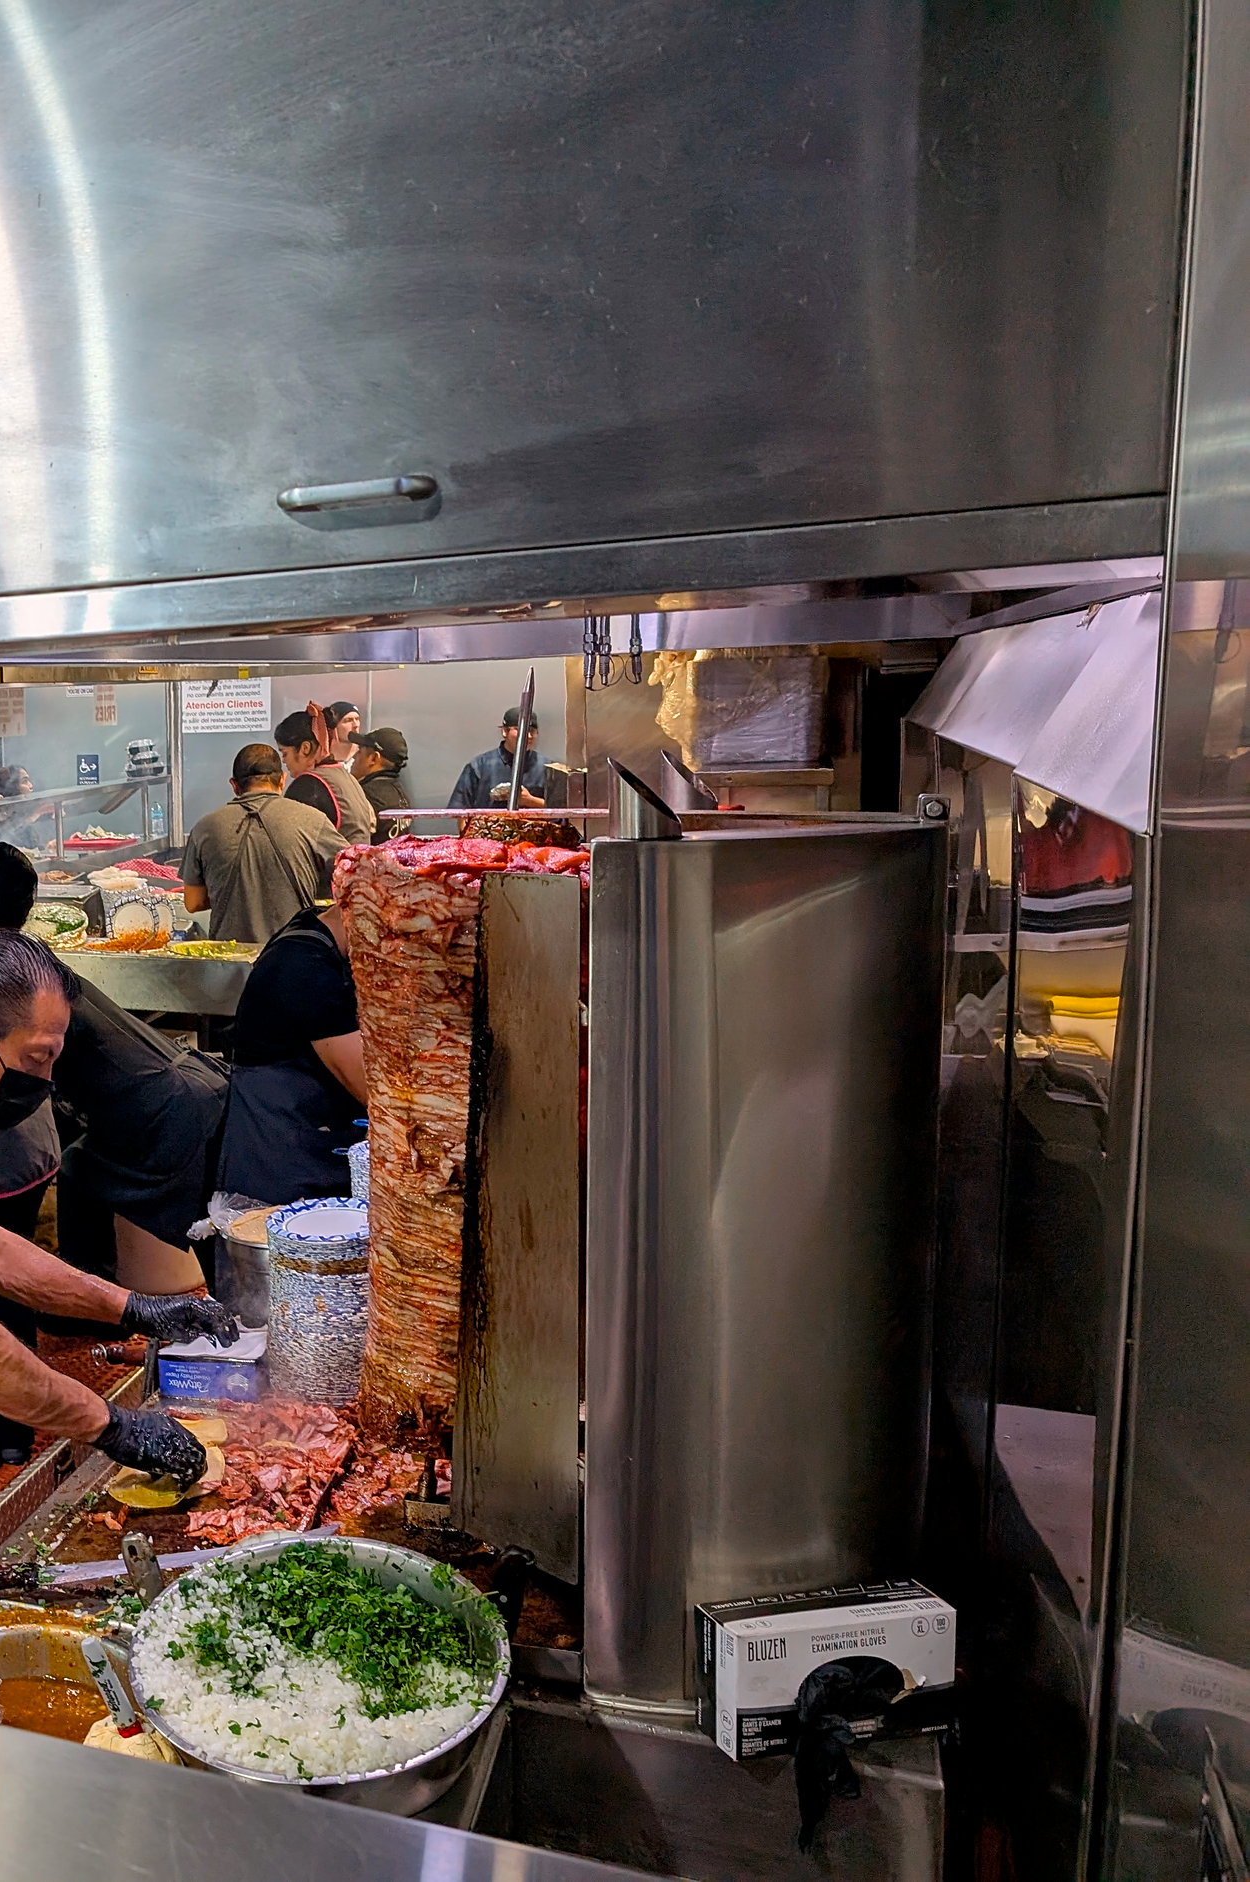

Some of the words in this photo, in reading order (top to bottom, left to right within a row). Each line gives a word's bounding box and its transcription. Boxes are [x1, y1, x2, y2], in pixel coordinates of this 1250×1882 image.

[185, 701, 225, 709] Atencion
[227, 700, 264, 709] Clientes
[936, 1617, 946, 1627] 100
[811, 1631, 859, 1643] POWDER-FREE
[860, 1627, 886, 1637] NITRILE
[916, 1624, 925, 1634] XL
[748, 1637, 787, 1662] BLUZEN
[811, 1640, 859, 1653] EXAMINATION
[860, 1636, 887, 1648] GLOVES
